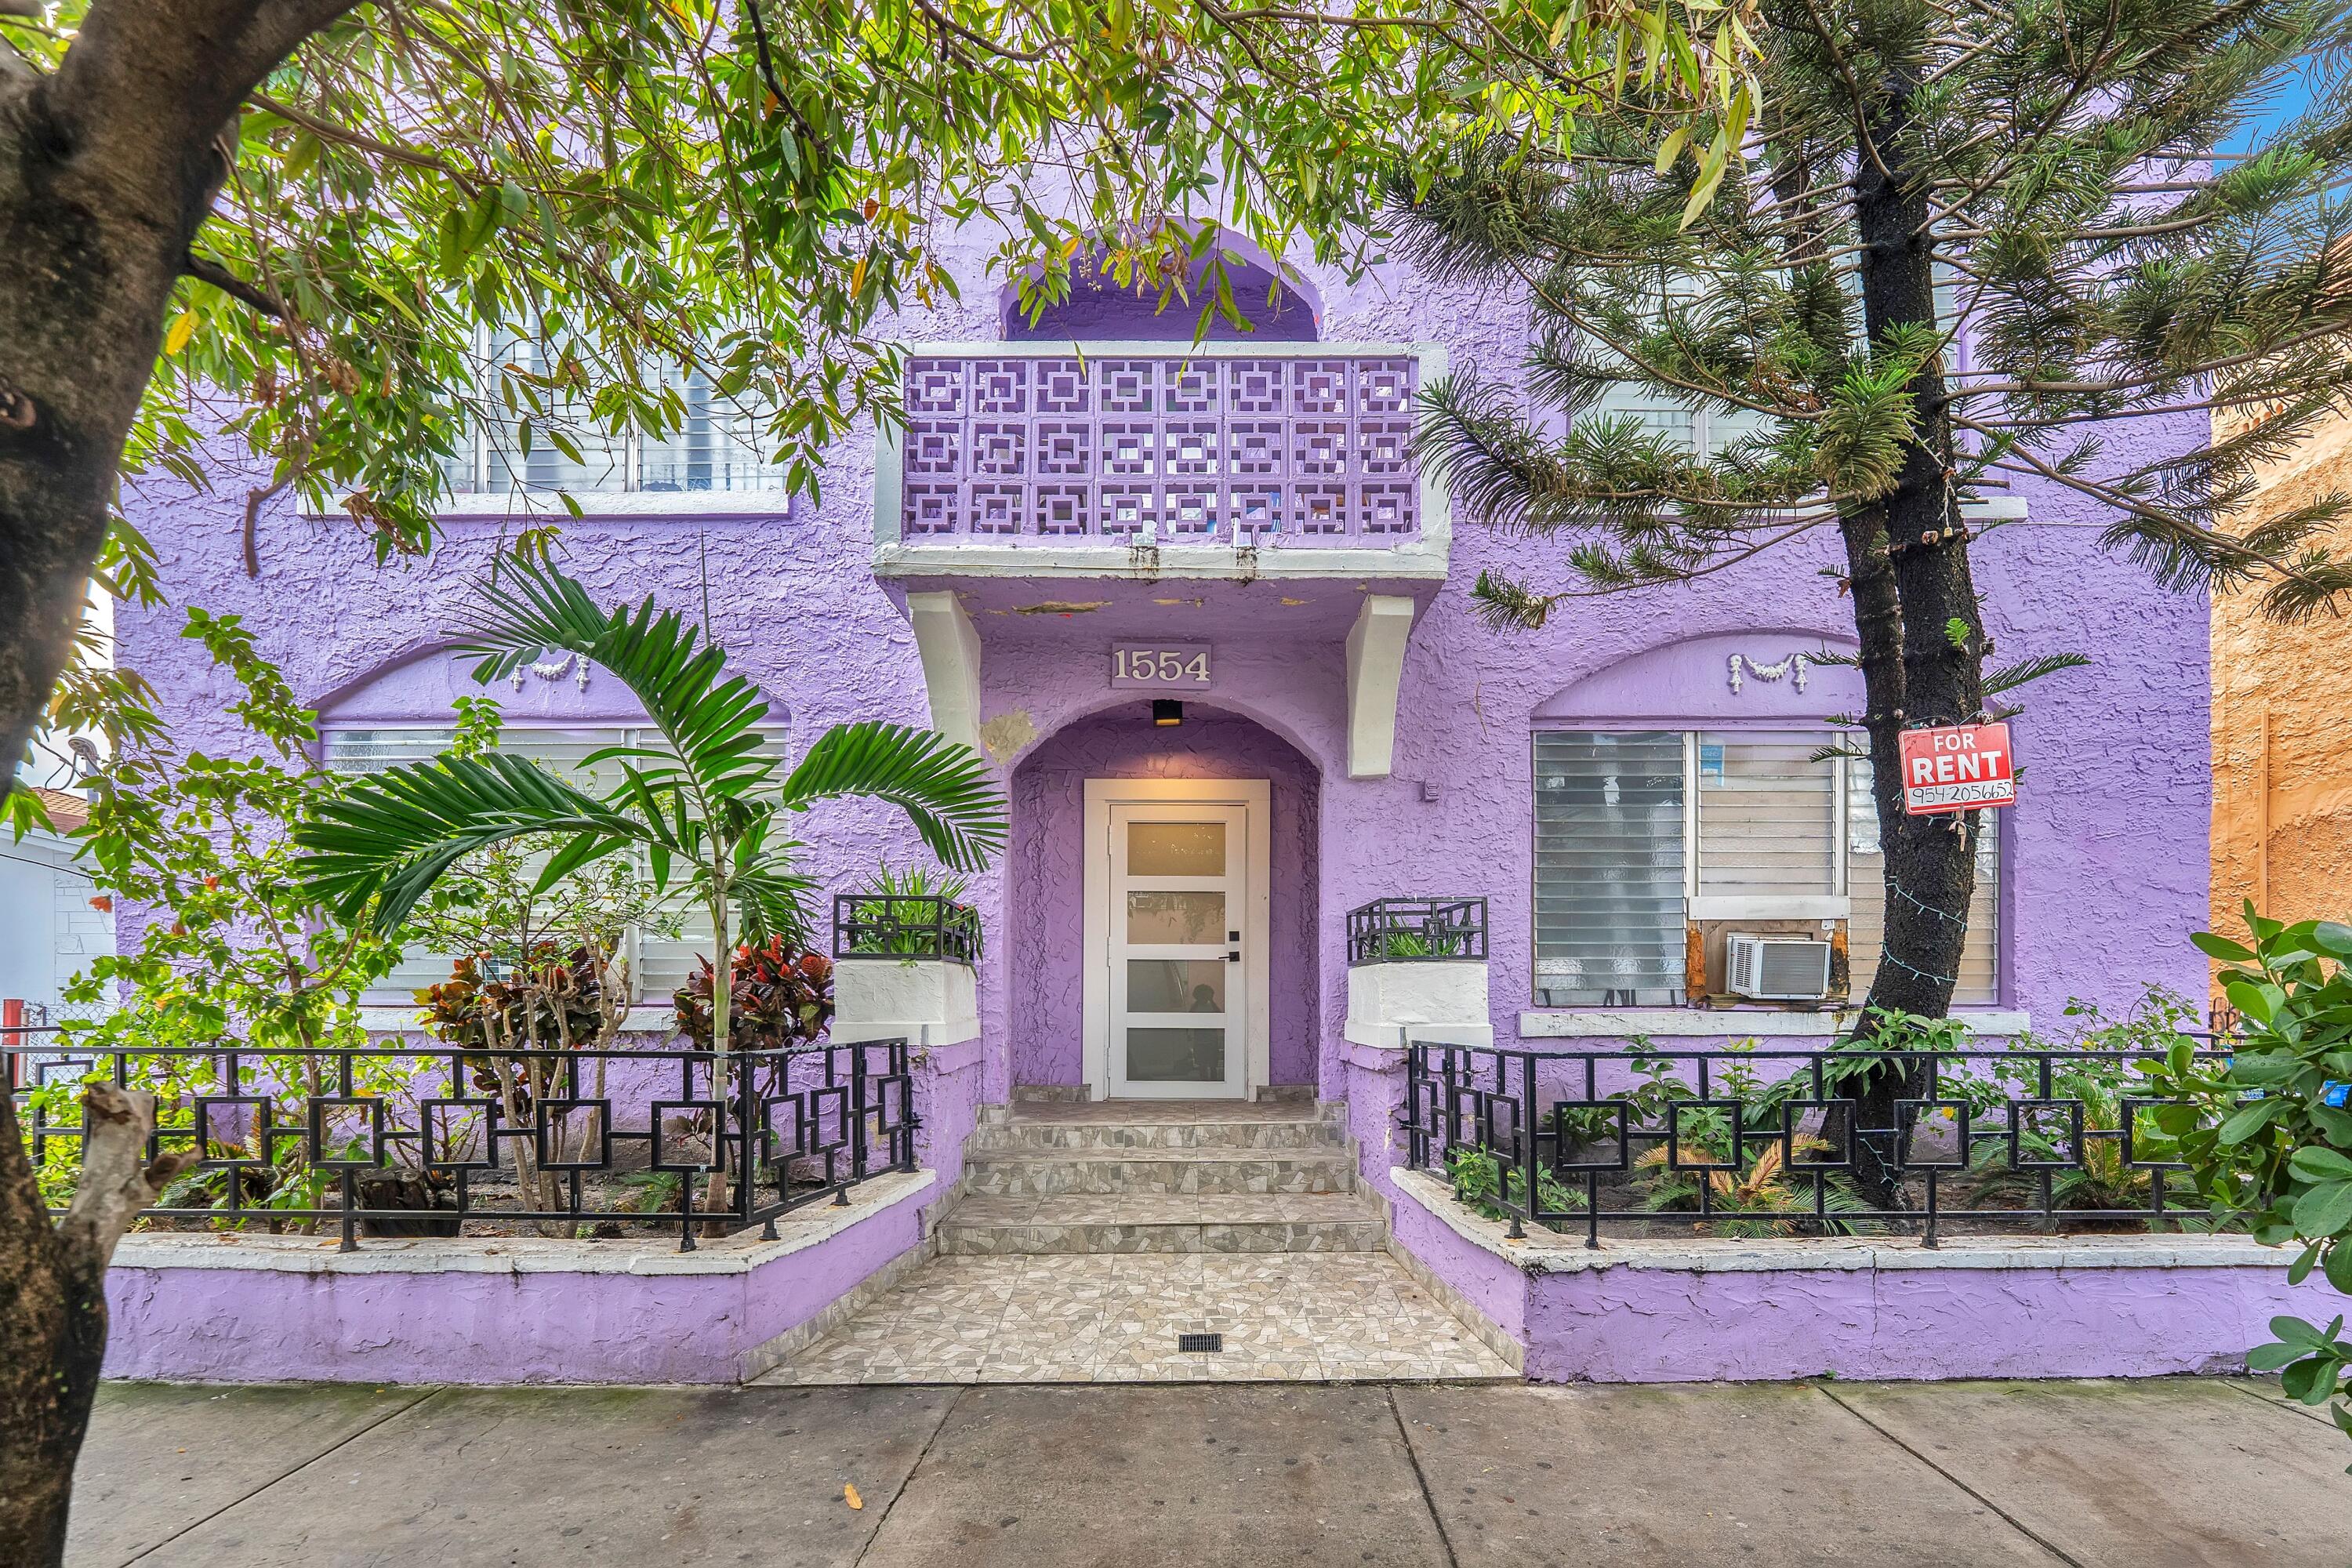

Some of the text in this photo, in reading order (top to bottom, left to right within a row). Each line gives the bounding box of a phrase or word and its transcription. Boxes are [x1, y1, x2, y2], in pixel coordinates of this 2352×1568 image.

[1114, 649, 1210, 681] 1554
[1933, 732, 1976, 753] FOR
[1911, 750, 2002, 785] RENT
[1912, 782, 2013, 804] 954-2056652
